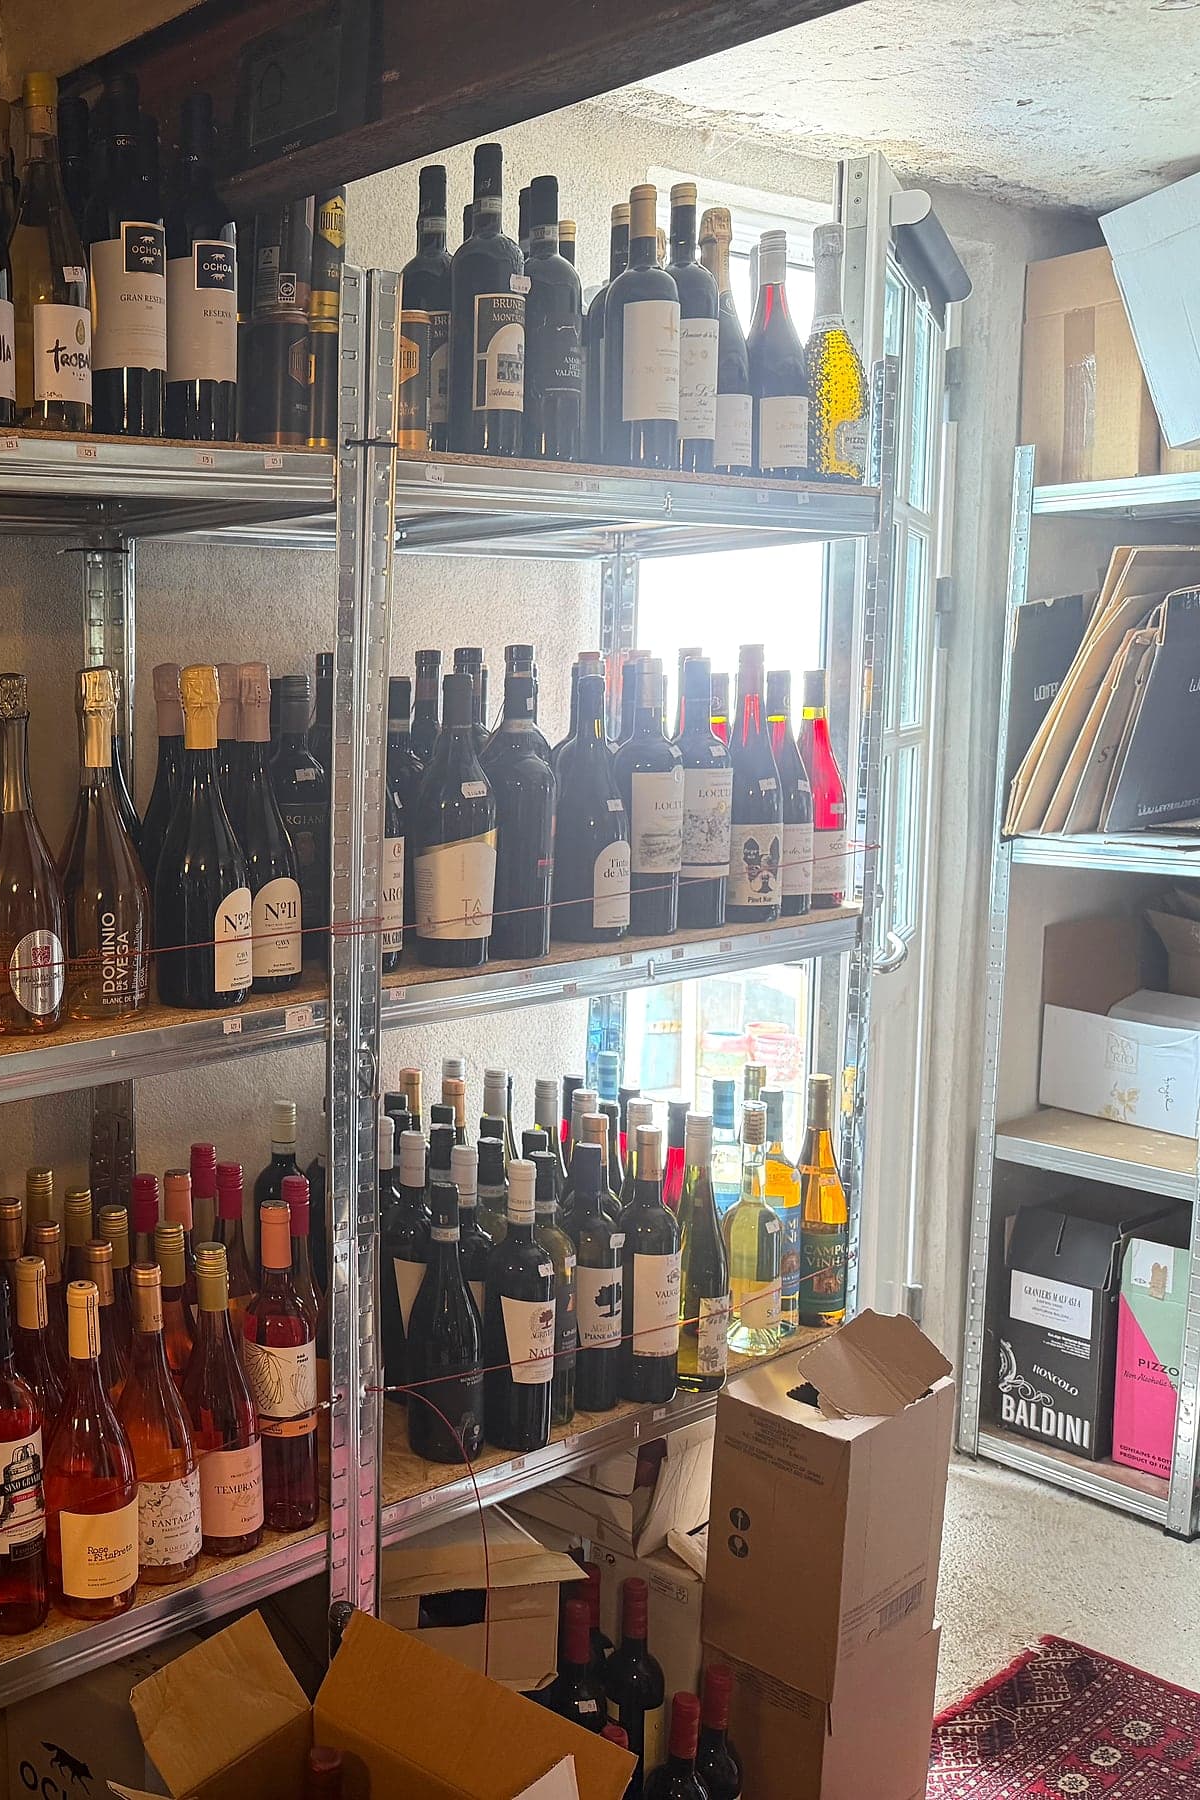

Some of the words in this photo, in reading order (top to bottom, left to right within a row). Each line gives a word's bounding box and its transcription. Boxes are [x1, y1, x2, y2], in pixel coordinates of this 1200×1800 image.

[132, 245, 161, 257] OCHOA
[203, 262, 232, 273] OCHOA
[120, 294, 143, 302] GRAN
[102, 911, 116, 993] DOMINIO
[116, 931, 129, 978] VEGA
[103, 995, 125, 1004] BLANC
[1138, 1358, 1180, 1377] PIZZO
[1033, 1364, 1079, 1397] RONCOLO
[1002, 1393, 1091, 1449] BALDINI
[1120, 1444, 1151, 1459] CONTAINS
[1120, 1451, 1148, 1465] PRODUCT
[20, 1760, 67, 1800] OC
